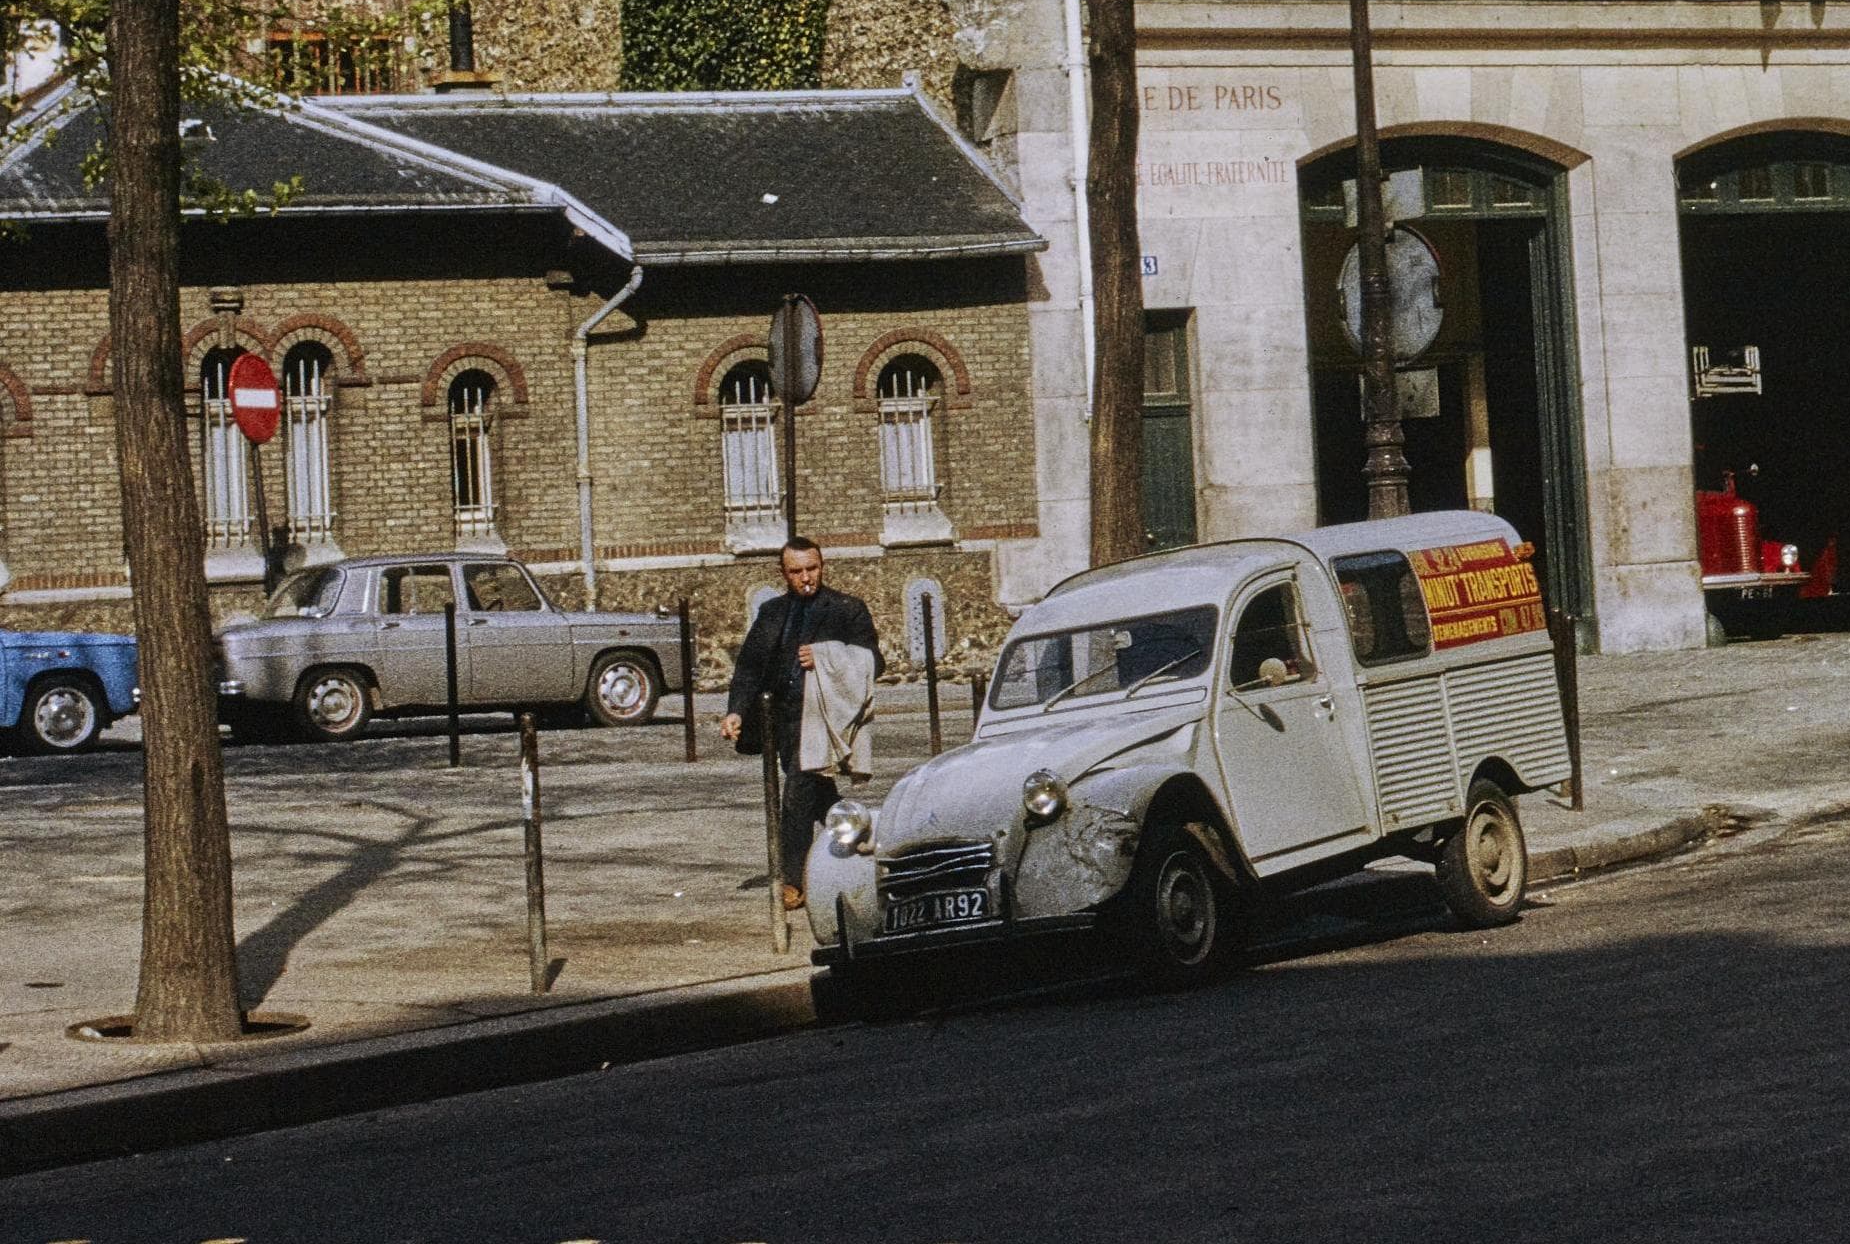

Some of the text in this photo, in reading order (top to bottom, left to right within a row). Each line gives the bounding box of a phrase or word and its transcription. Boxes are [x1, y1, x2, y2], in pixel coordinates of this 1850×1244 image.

[1168, 85, 1201, 110] DE
[1215, 85, 1283, 110] PARIS
[1459, 562, 1540, 604] TRANSPORTS
